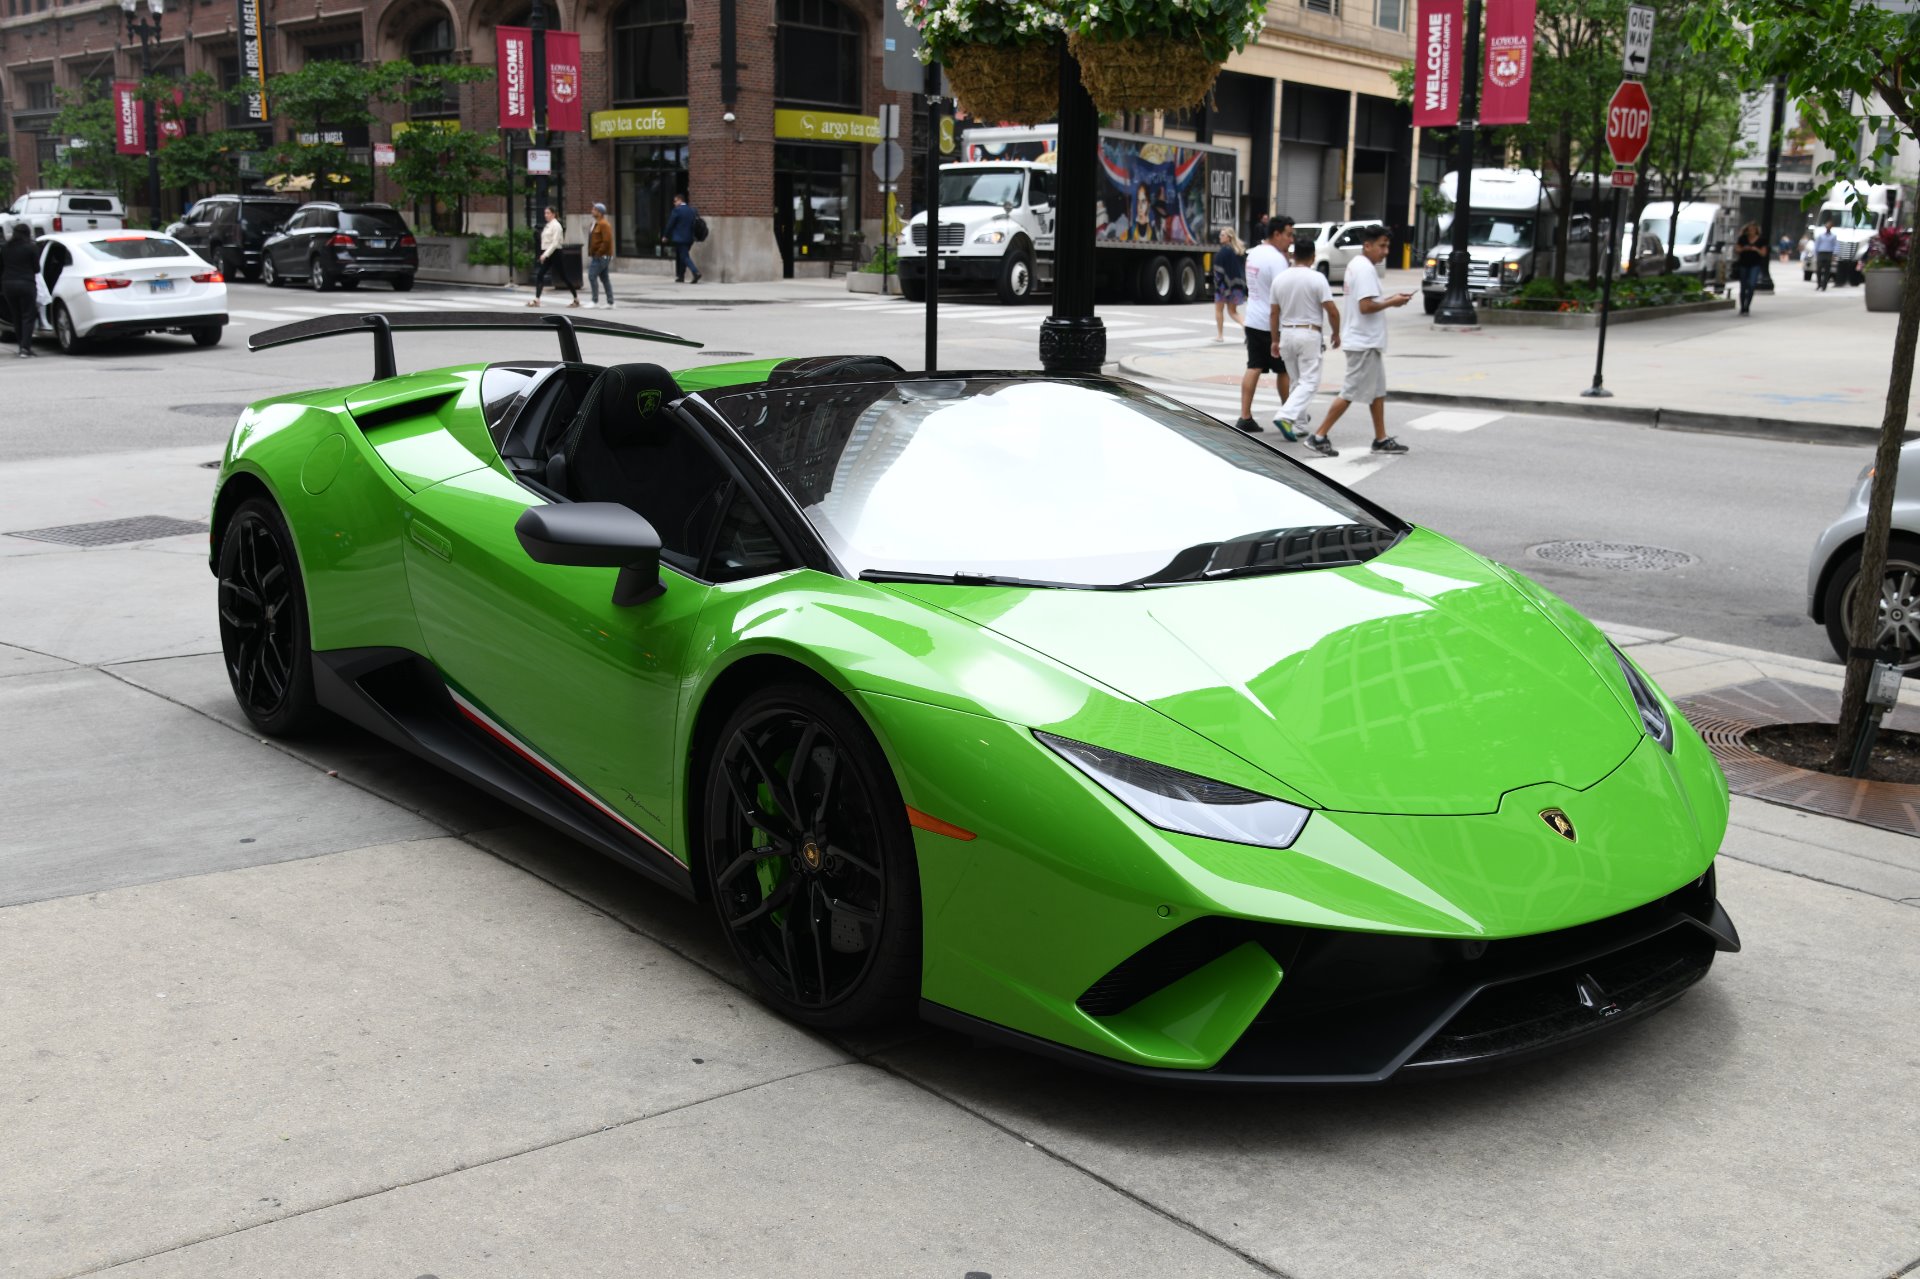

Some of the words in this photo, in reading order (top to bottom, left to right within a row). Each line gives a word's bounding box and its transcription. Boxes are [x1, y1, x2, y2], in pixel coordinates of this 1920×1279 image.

[1443, 13, 1452, 49] CAMPUS
[1630, 12, 1651, 30] ONE
[245, 39, 259, 68] BROS.
[1491, 36, 1527, 47] LOYOLA
[1629, 30, 1649, 49] WAY
[551, 64, 576, 73] LOYOLA
[1425, 13, 1442, 111] WELCOME
[1441, 50, 1450, 80] TOWER
[506, 39, 519, 116] WELCOME
[248, 69, 262, 119] EINSN
[1440, 81, 1449, 111] WATER
[121, 91, 133, 145] WELCOME
[636, 109, 666, 130] café
[821, 121, 848, 139] argo
[850, 121, 864, 136] tea
[1609, 107, 1648, 139] STOP
